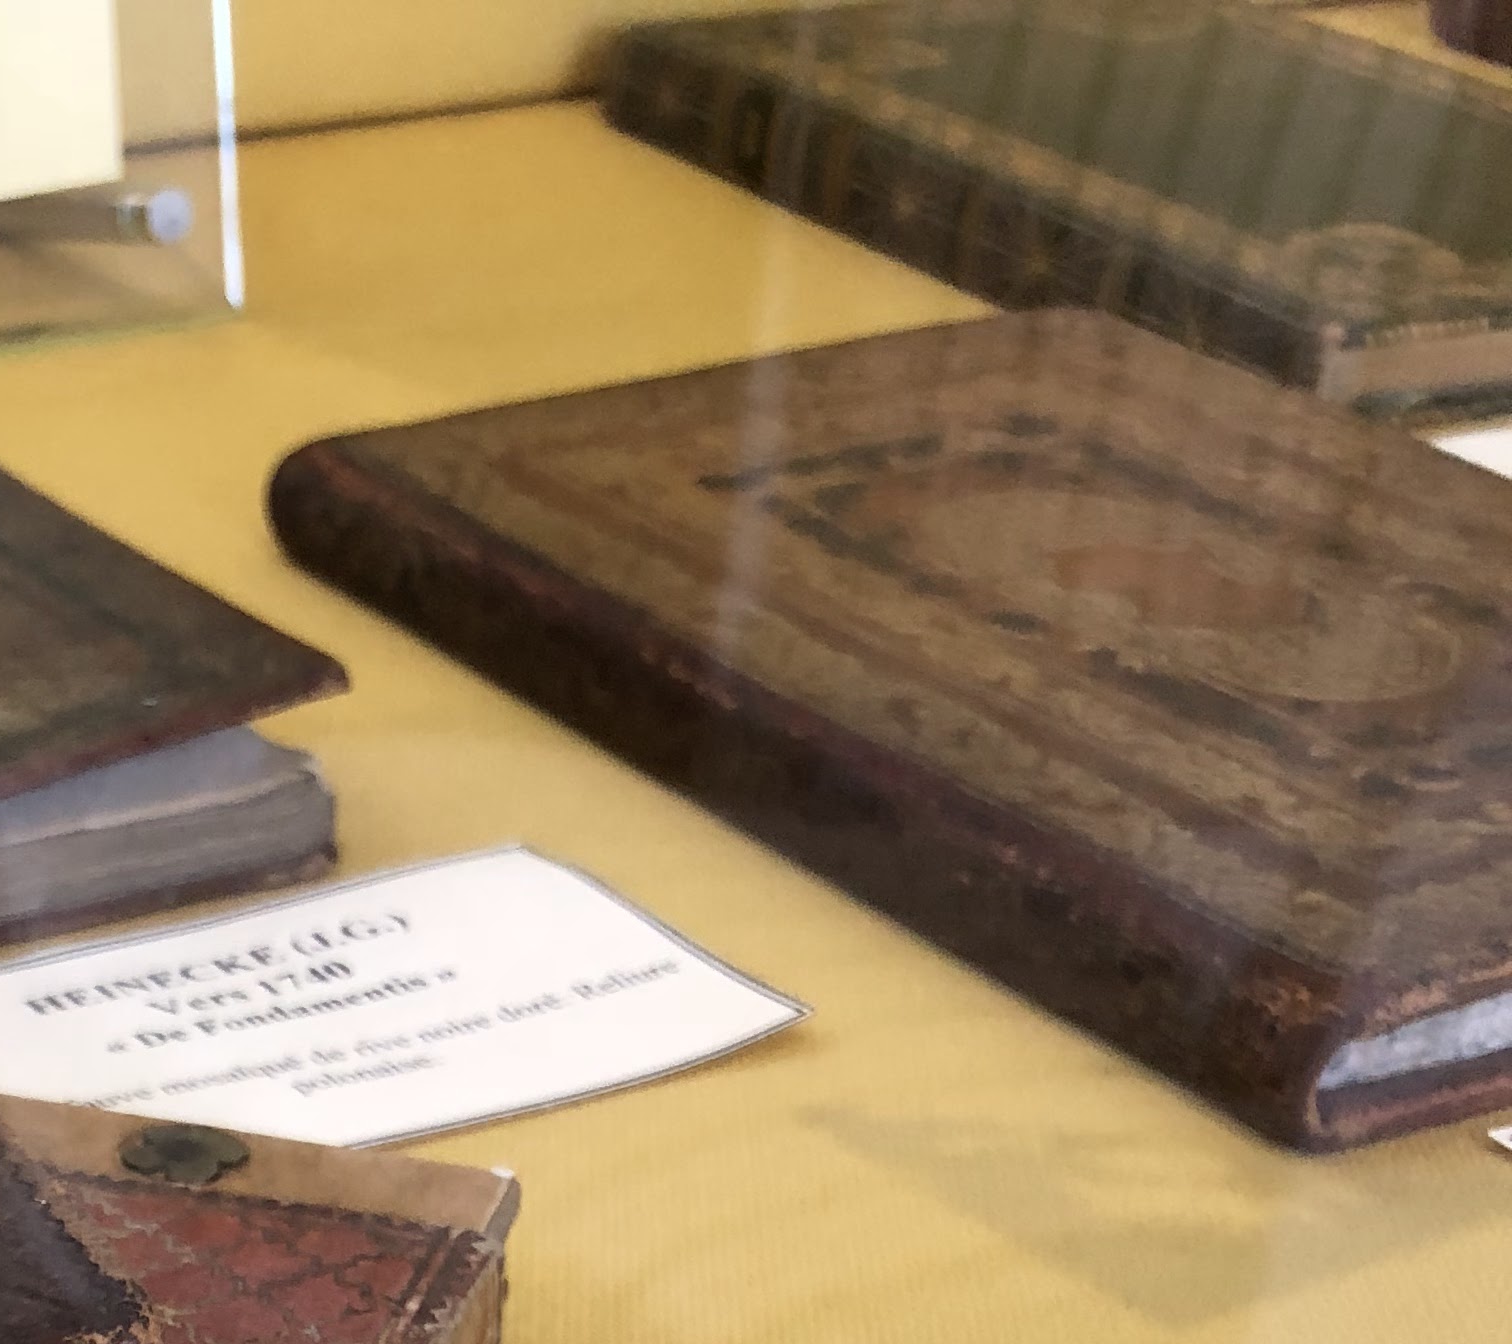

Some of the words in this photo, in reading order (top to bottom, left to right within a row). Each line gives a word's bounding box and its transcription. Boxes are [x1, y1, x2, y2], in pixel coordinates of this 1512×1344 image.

[24, 945, 285, 1015] HEINECKE
[290, 911, 410, 957] (J.G.)
[144, 988, 251, 1016] Vers
[257, 961, 354, 996] 1740
[133, 1024, 189, 1048] De
[192, 973, 429, 1036] Fondamentis
[308, 1048, 346, 1065] de
[417, 1012, 493, 1043] noire
[571, 957, 681, 1001] Reliure
